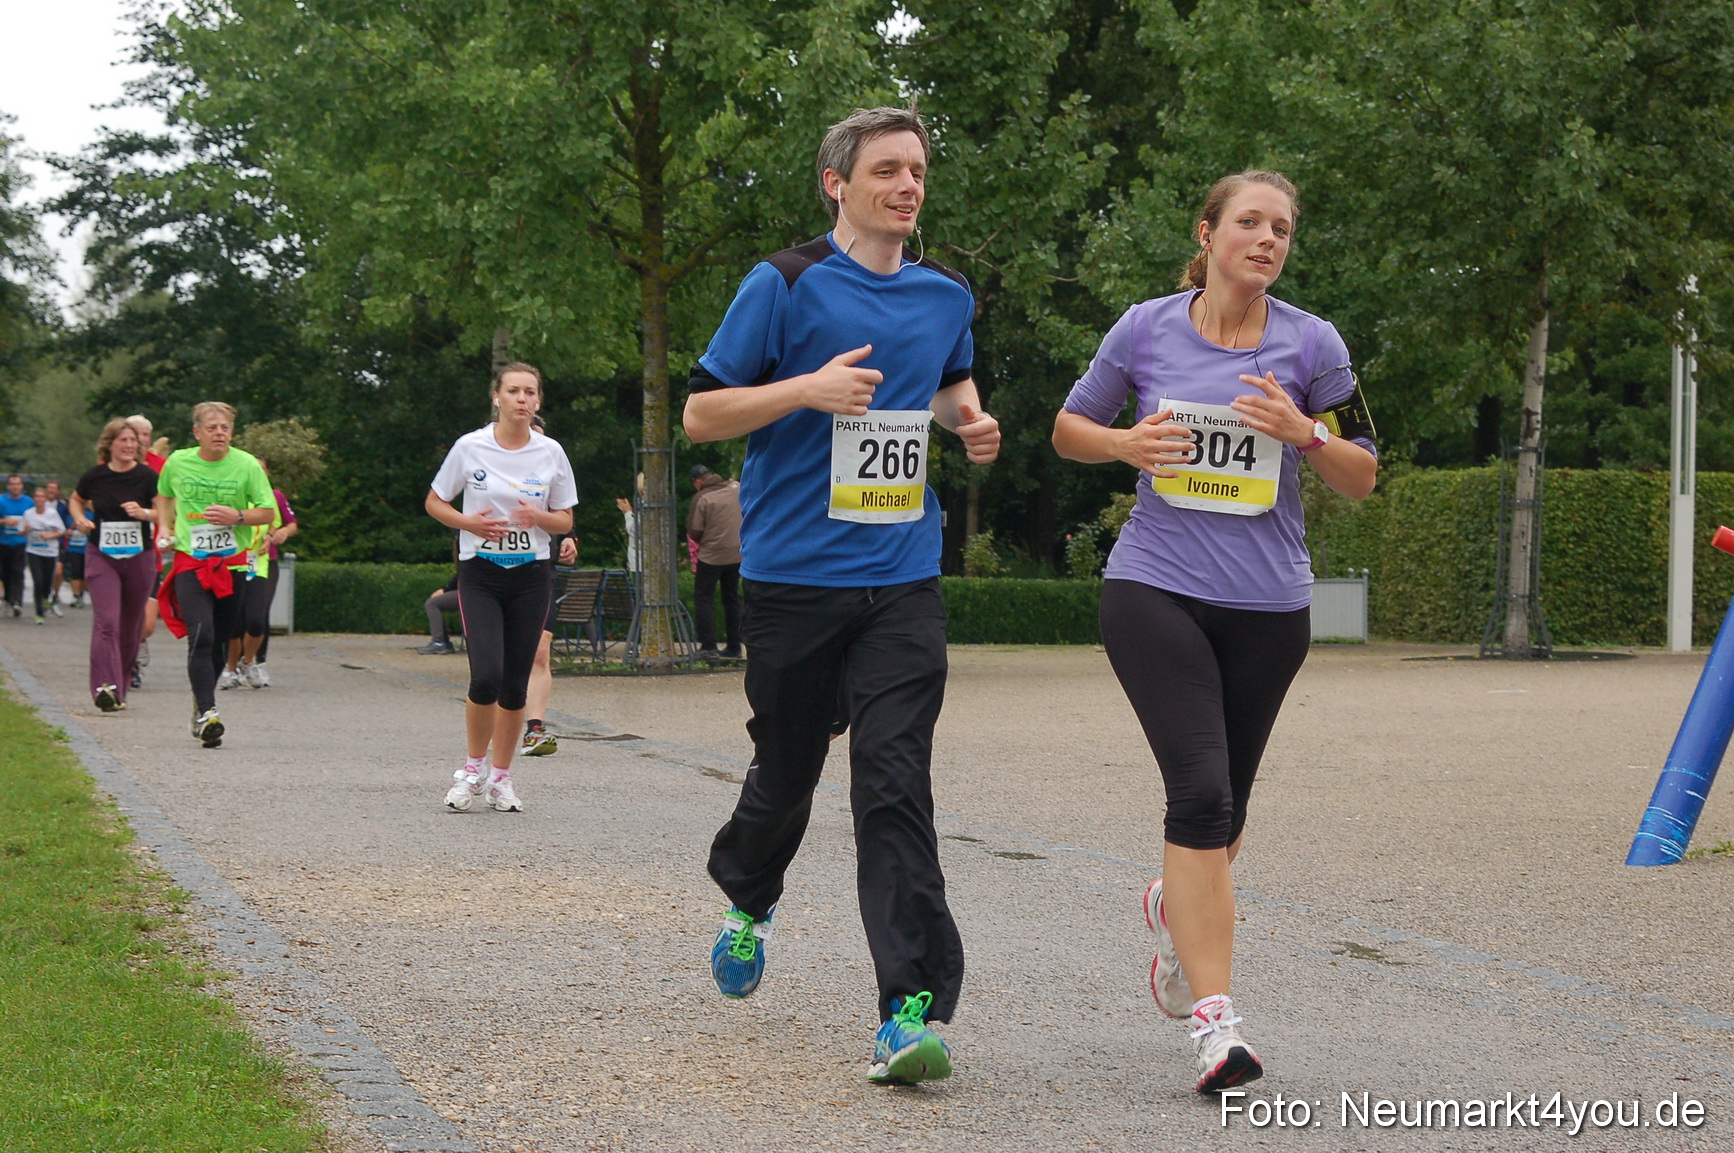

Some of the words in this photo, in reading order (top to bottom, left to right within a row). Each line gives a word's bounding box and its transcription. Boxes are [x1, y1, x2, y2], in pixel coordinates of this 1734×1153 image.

[1161, 410, 1200, 425] ARTL
[835, 421, 876, 432] PARTL
[878, 422, 925, 433] Neumarkt
[857, 438, 921, 480] 266
[1187, 477, 1240, 498] Ivonne
[861, 491, 911, 508] Michael
[105, 531, 138, 545] 2015
[196, 531, 232, 550] 2122
